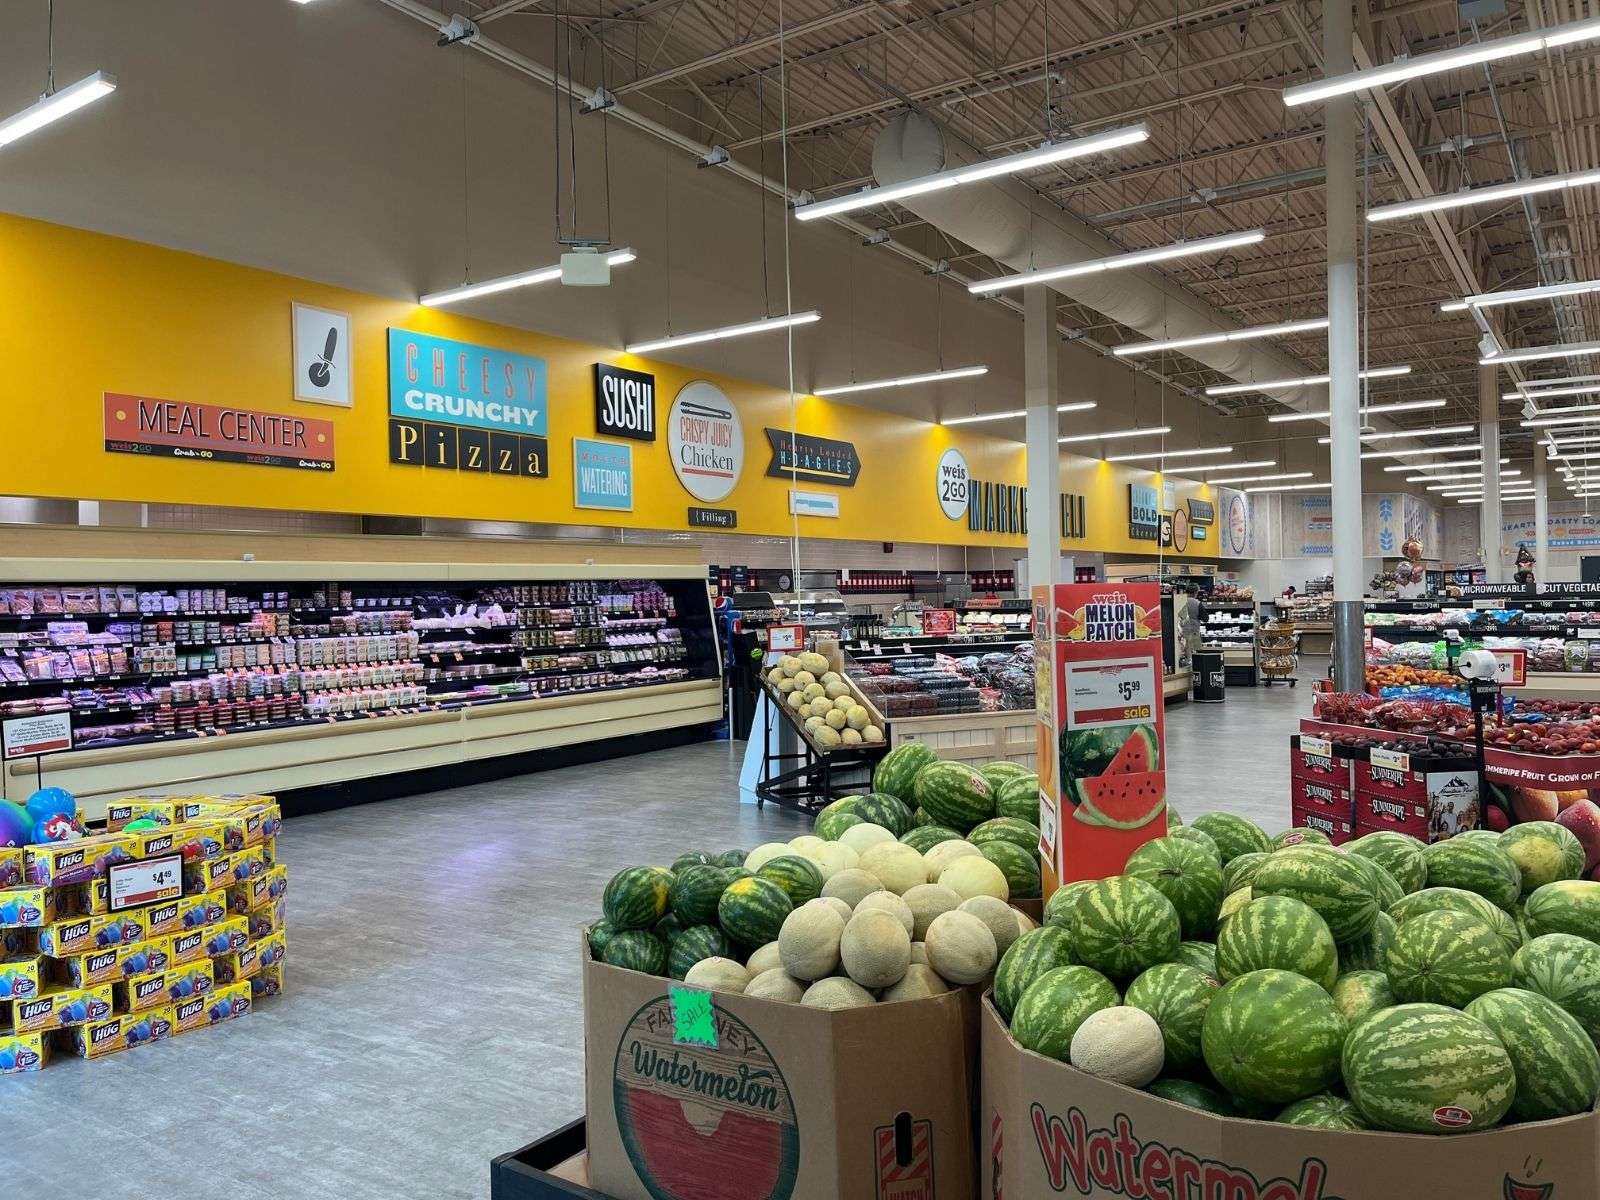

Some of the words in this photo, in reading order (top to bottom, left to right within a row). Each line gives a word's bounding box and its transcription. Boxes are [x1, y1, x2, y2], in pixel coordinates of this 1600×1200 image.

[406, 343, 536, 402] CHEESY
[404, 389, 539, 427] CRUNCHY
[602, 374, 653, 432] SUSHI
[138, 399, 210, 437] MEAL
[218, 410, 307, 448] CENTER
[680, 416, 709, 444] CRISPY
[711, 422, 733, 449] JUICY
[397, 425, 542, 474] Pizza
[681, 444, 733, 471] Chicken
[942, 464, 967, 480] weis
[581, 466, 628, 497] WATERING
[942, 480, 967, 502] 2GO
[968, 479, 1028, 535] MARKE
[1061, 493, 1086, 538] ELI
[1133, 506, 1157, 523] BOLD
[701, 511, 727, 525] Filling
[1462, 585, 1527, 594] MICROWAVEABLE
[1544, 583, 1561, 593] CUT
[1092, 591, 1127, 604] weis
[1085, 603, 1135, 622] MELON
[1085, 622, 1135, 641] PATCH
[1123, 706, 1150, 719] sale
[112, 808, 131, 820] HUG
[149, 838, 171, 853] HUG
[59, 853, 83, 868] HUG
[157, 887, 178, 898] sale
[154, 907, 177, 924] HUG
[64, 924, 89, 941] HUG
[179, 935, 200, 952] HUG
[27, 965, 35, 973] 20
[91, 953, 116, 971] HUG
[140, 979, 163, 996] HUG
[24, 1001, 51, 1018] HUG
[181, 1001, 203, 1020] HUG
[95, 1023, 119, 1042] HUG
[629, 1040, 780, 1111] Watermelon
[1030, 1102, 1346, 1200] Waterm
